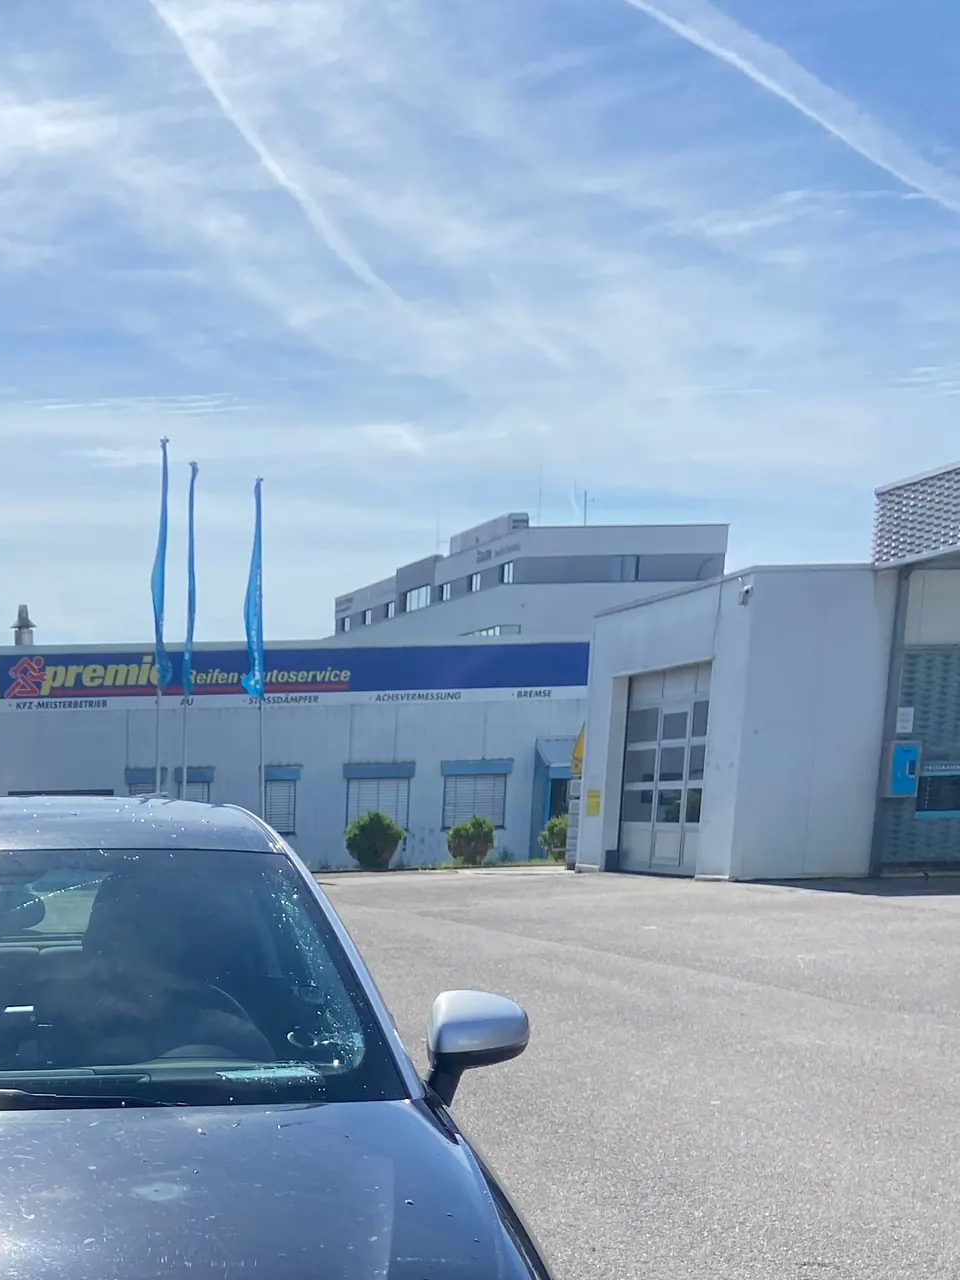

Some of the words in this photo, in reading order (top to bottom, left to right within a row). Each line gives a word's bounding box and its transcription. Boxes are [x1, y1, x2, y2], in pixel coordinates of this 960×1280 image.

[264, 667, 351, 682] utoservice
[375, 692, 461, 702] ACHSVERMESSUNG
[517, 689, 552, 698] BREMSE
[15, 700, 108, 710] KFZ-MEISTERBETRIEB
